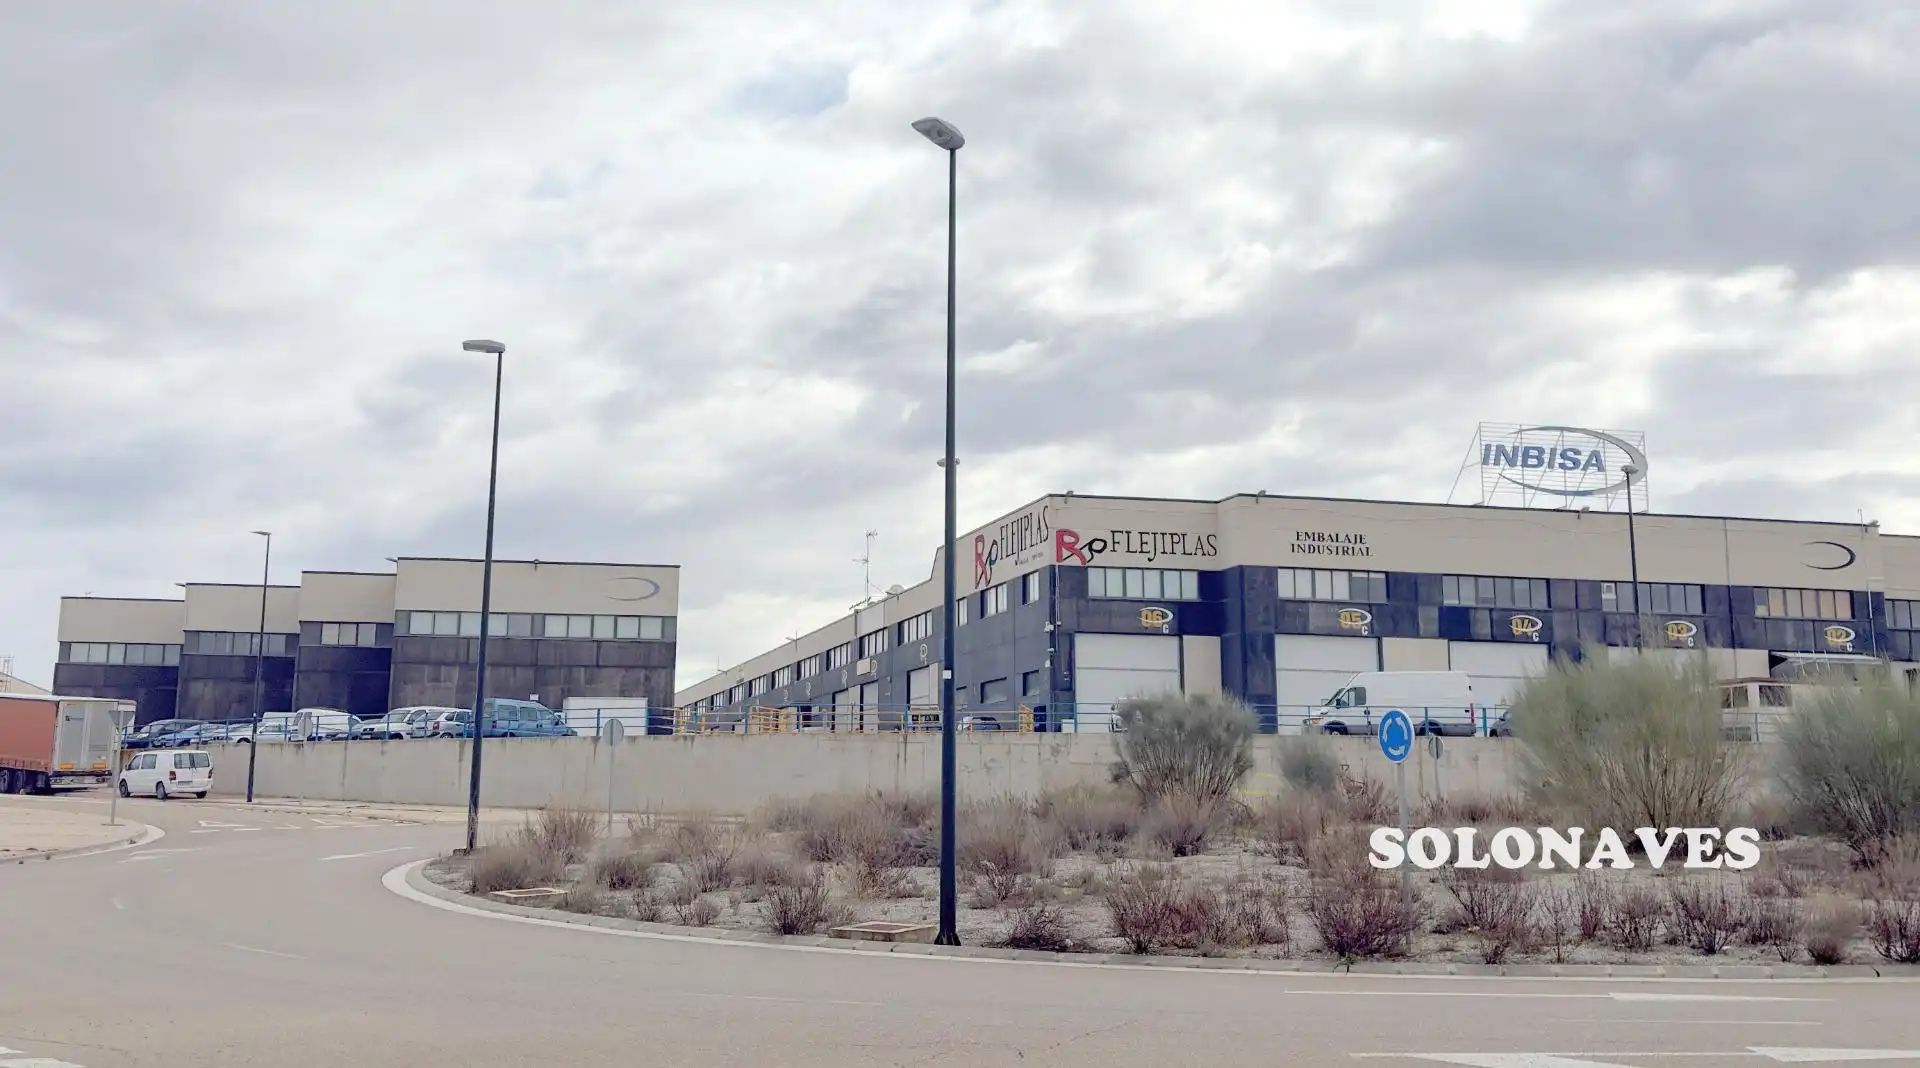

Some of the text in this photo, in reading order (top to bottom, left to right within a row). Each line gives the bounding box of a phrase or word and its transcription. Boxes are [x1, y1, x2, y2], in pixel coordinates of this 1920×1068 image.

[1482, 443, 1605, 473] INBISA
[1000, 505, 1049, 561] FLEJIPLAS
[1110, 530, 1218, 562] FLEJIPLAS
[1295, 531, 1367, 545] EMBALAJE
[1291, 543, 1375, 557] INDUSTRIAL
